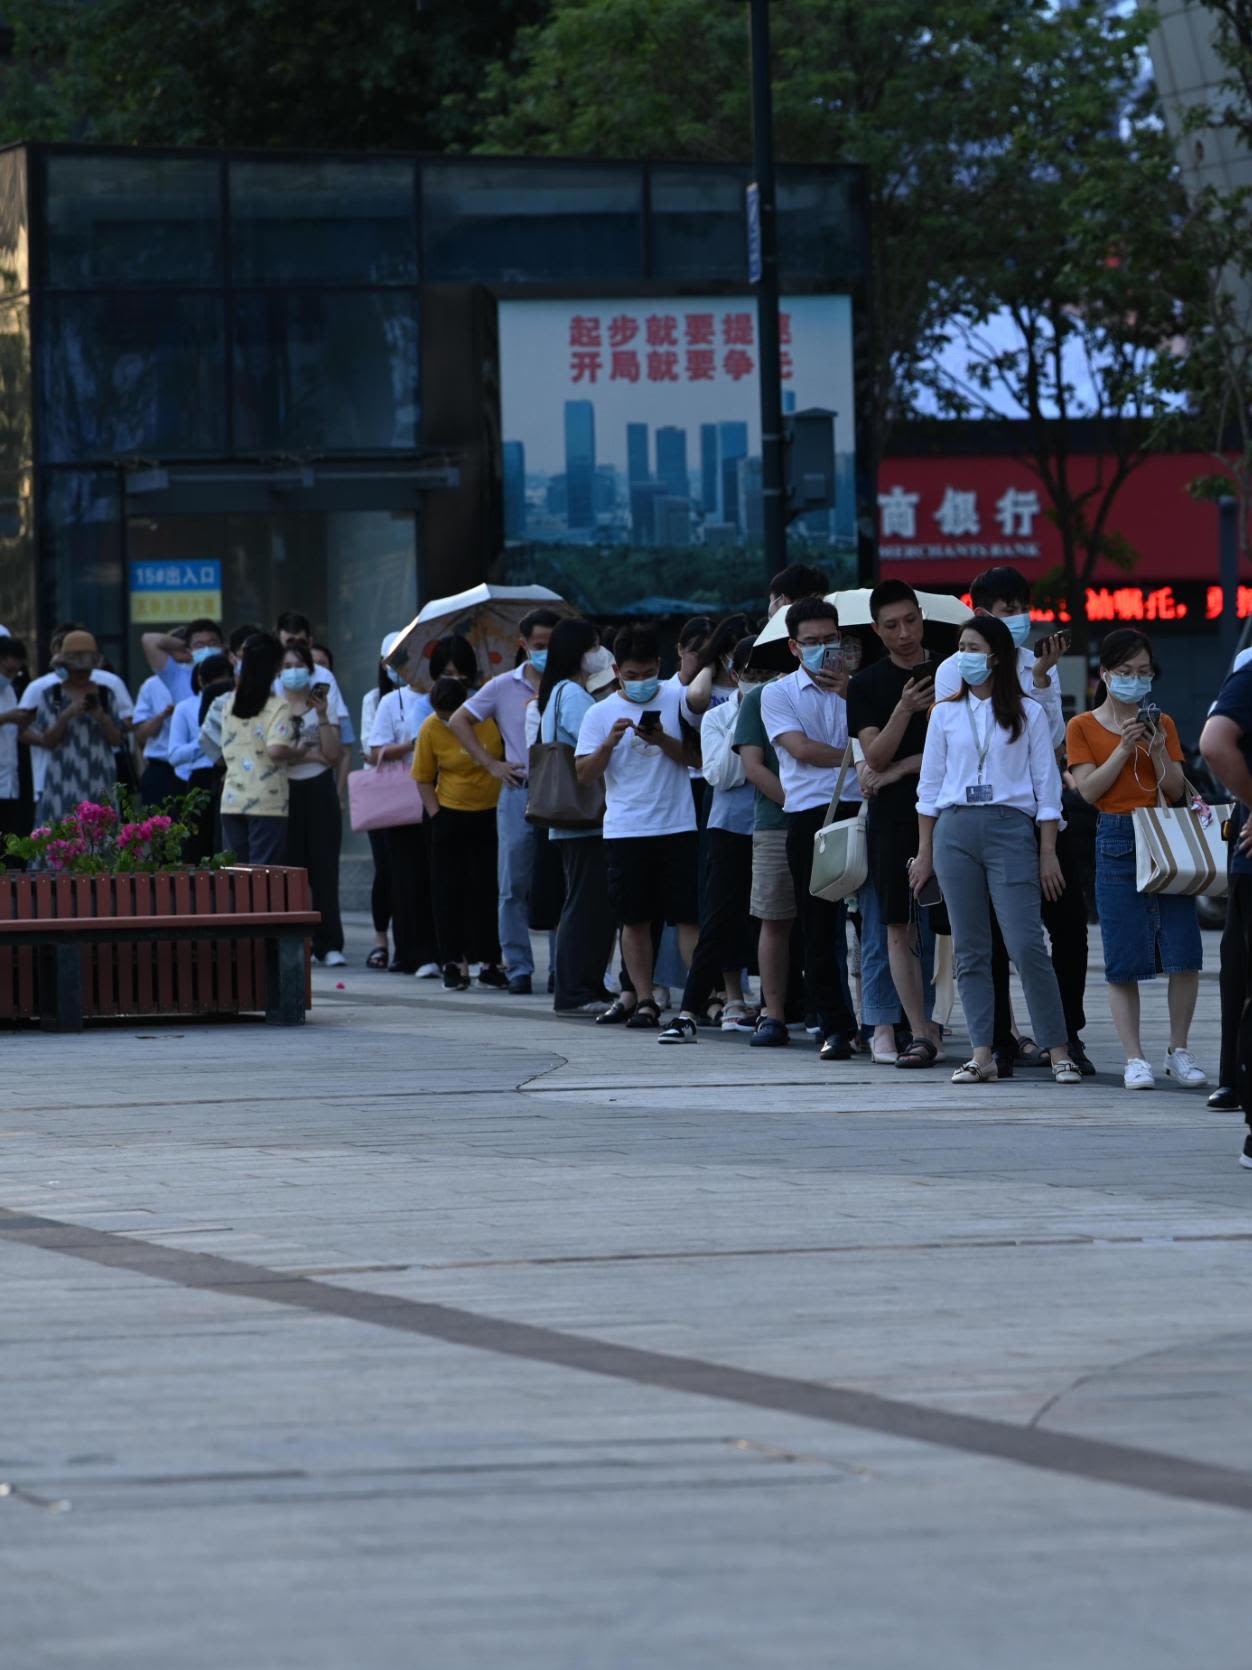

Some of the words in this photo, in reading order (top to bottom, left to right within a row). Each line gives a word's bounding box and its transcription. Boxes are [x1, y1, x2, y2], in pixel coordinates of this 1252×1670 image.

[877, 486, 1041, 538] 商银行
[990, 542, 1040, 558] BANK
